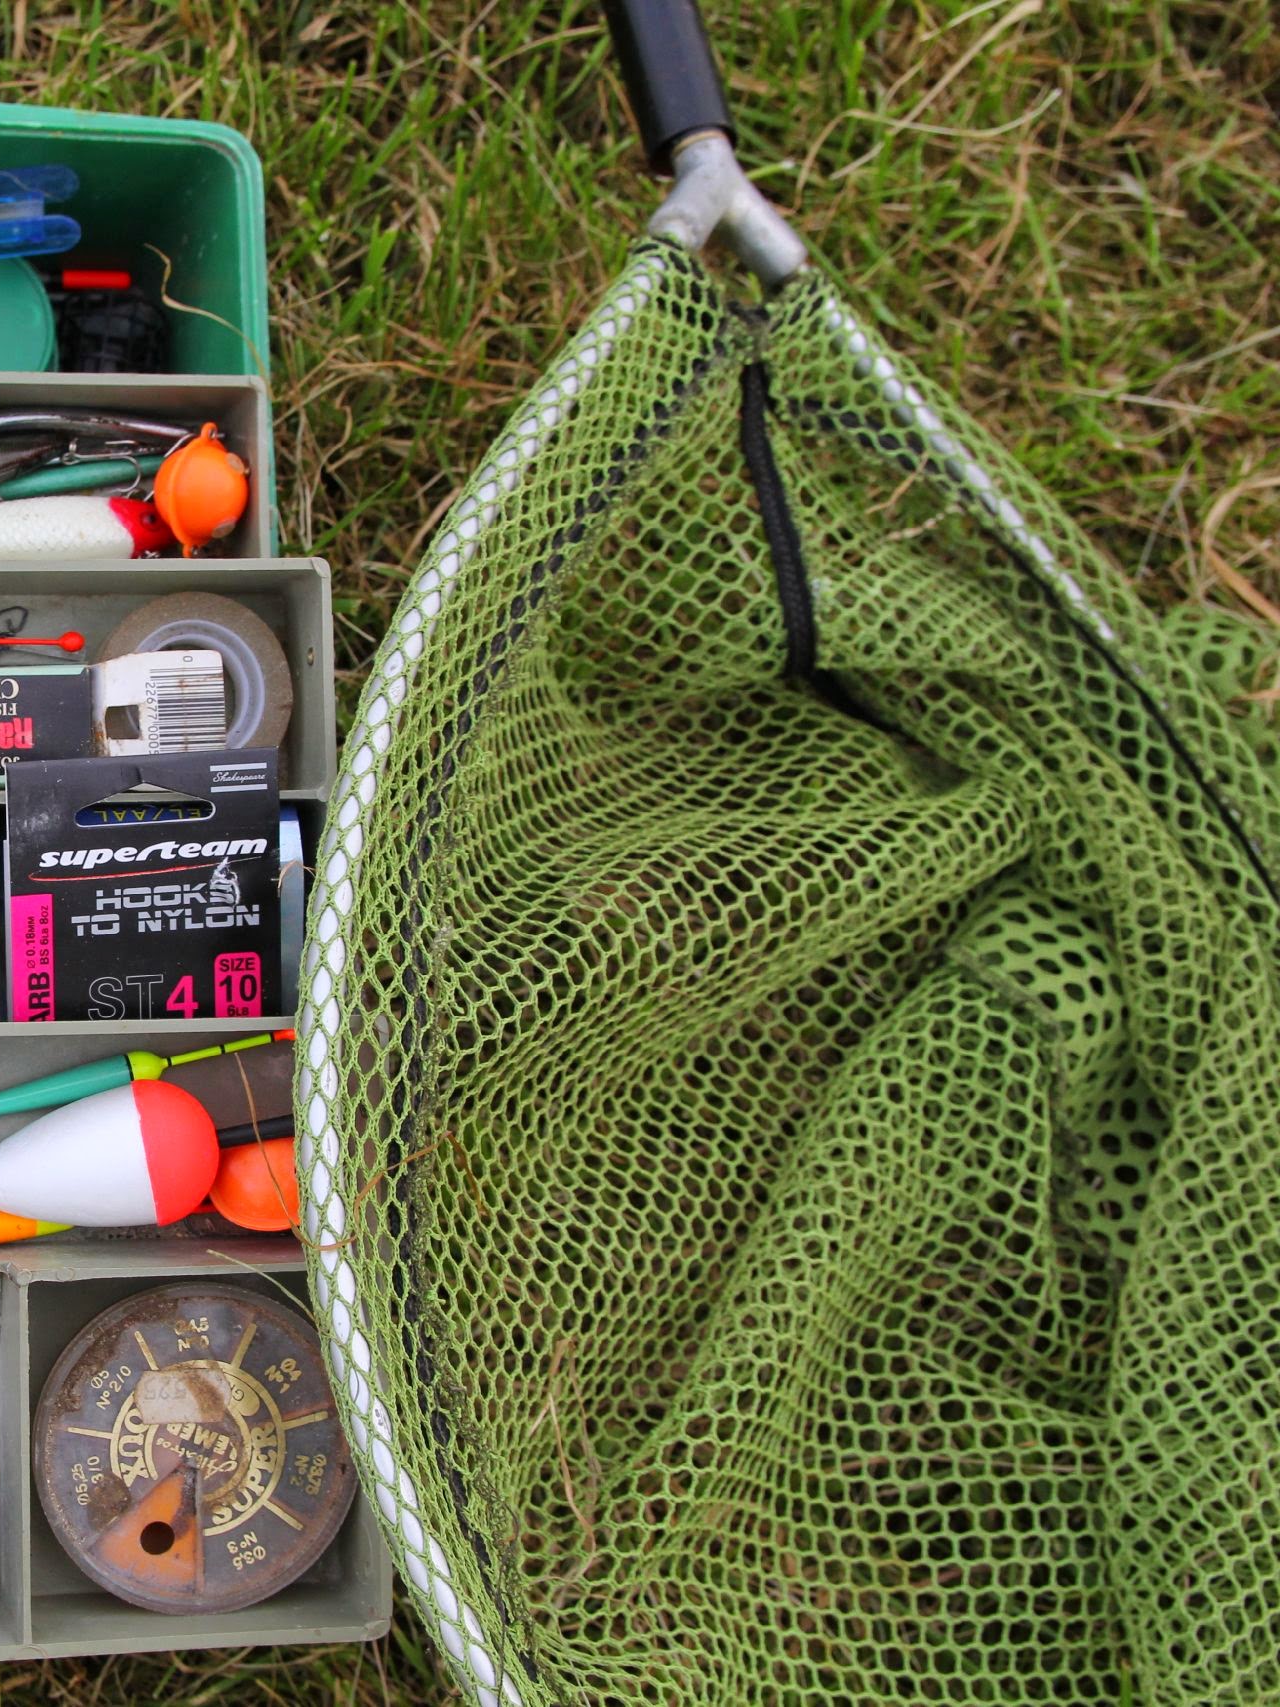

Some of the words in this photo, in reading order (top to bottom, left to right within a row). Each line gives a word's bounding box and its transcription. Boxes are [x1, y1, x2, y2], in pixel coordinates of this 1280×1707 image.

[182, 654, 193, 664] 0
[145, 680, 159, 721] 22677
[213, 771, 267, 784] Shakespeare
[39, 837, 268, 870] superteam
[96, 883, 234, 911] HOOKS
[71, 913, 120, 937] TO
[138, 904, 260, 934] NYLON
[39, 949, 50, 966] BS
[219, 957, 255, 973] SIZE
[218, 974, 258, 1002] 10
[227, 1004, 250, 1018] 6LB
[211, 1421, 278, 1526] SUPER
